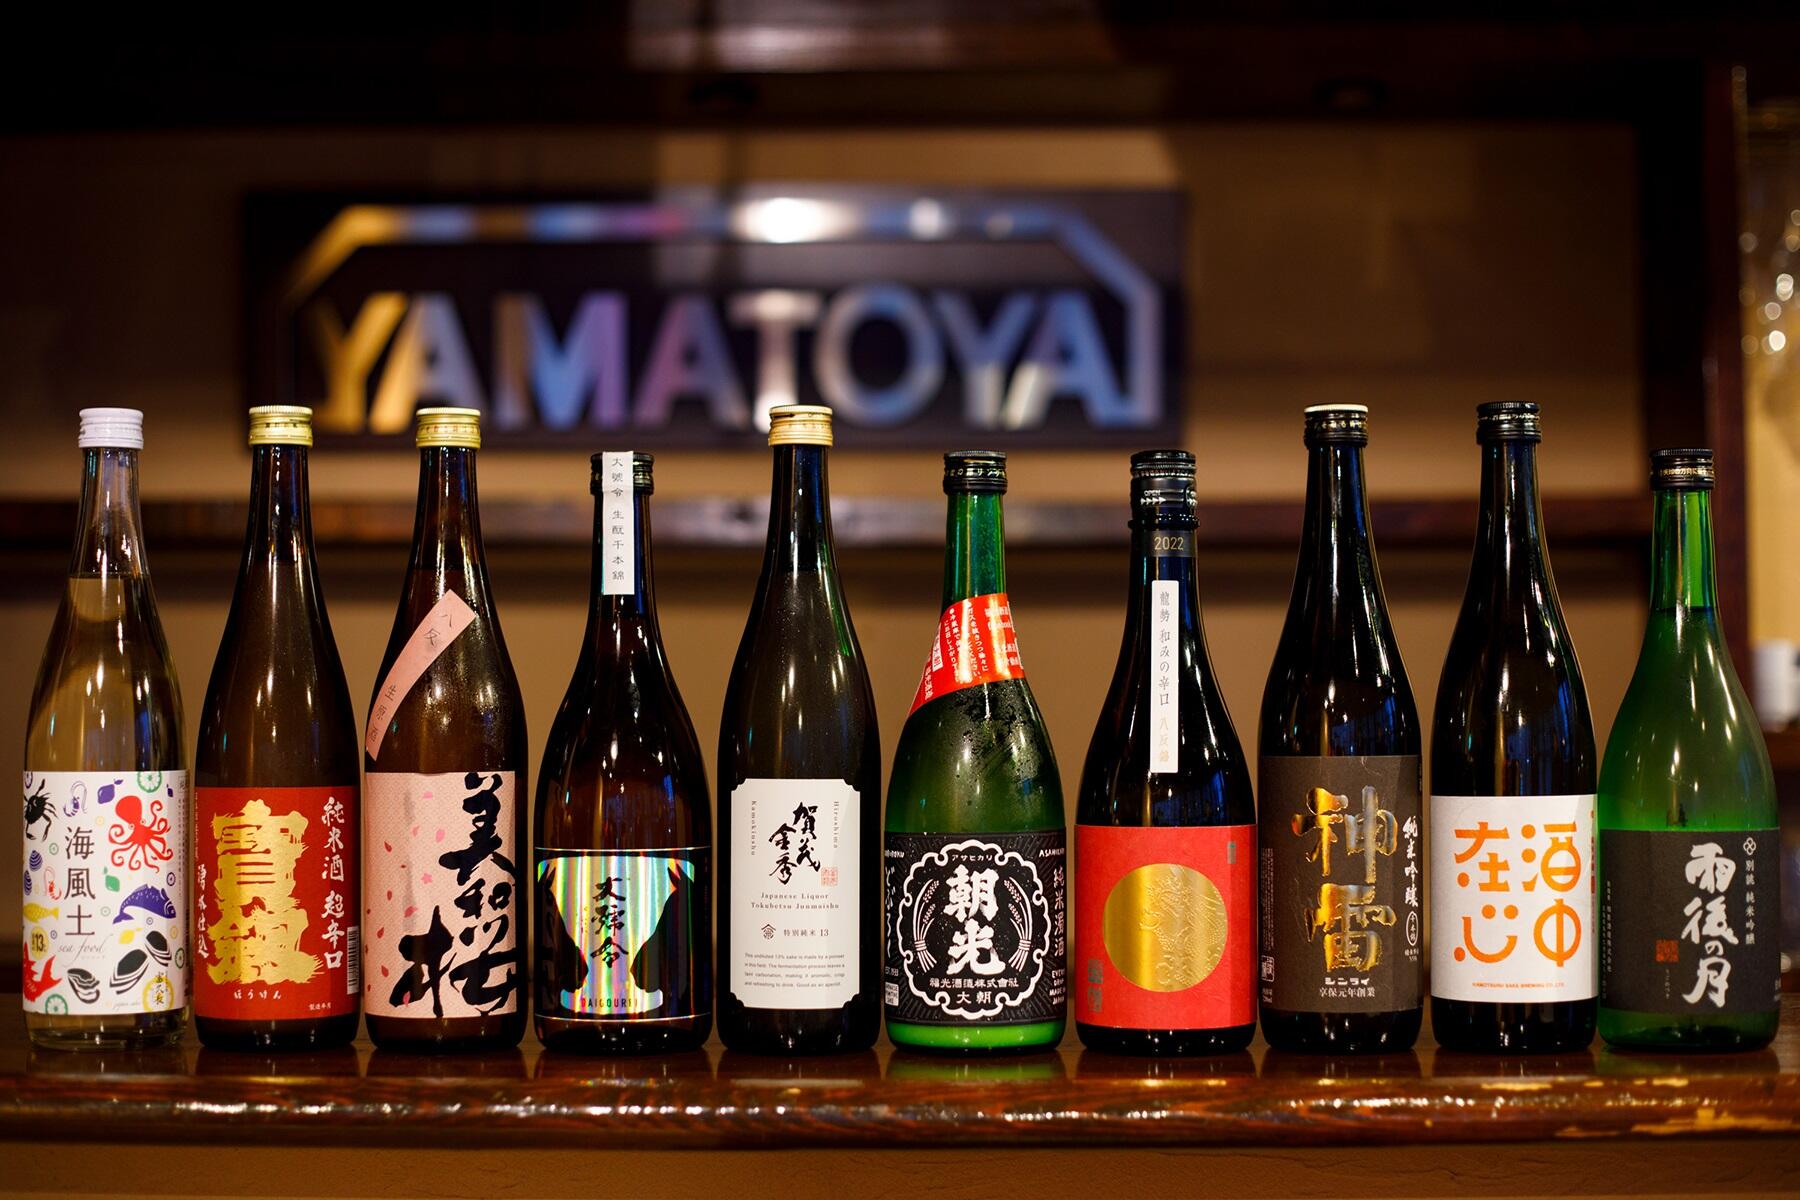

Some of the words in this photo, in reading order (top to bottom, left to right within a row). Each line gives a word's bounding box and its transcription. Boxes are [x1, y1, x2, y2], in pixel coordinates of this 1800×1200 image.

[308, 285, 1122, 434] YAMATOYA
[1154, 537, 1184, 550] 2022
[321, 797, 345, 882] 純米酒
[951, 854, 993, 862] アサヒカリ
[64, 826, 96, 937] 海風土
[761, 892, 798, 900] Japanese
[943, 864, 1006, 975] 朝光
[1453, 821, 1520, 964] 在心
[1520, 821, 1582, 968] 酒中
[35, 932, 44, 952] 13
[321, 891, 345, 969] 超辛口
[820, 929, 829, 937] 13
[1681, 842, 1740, 1008] 雨後の月
[233, 988, 282, 1000] ほうけん
[956, 991, 992, 1005] 大朝
